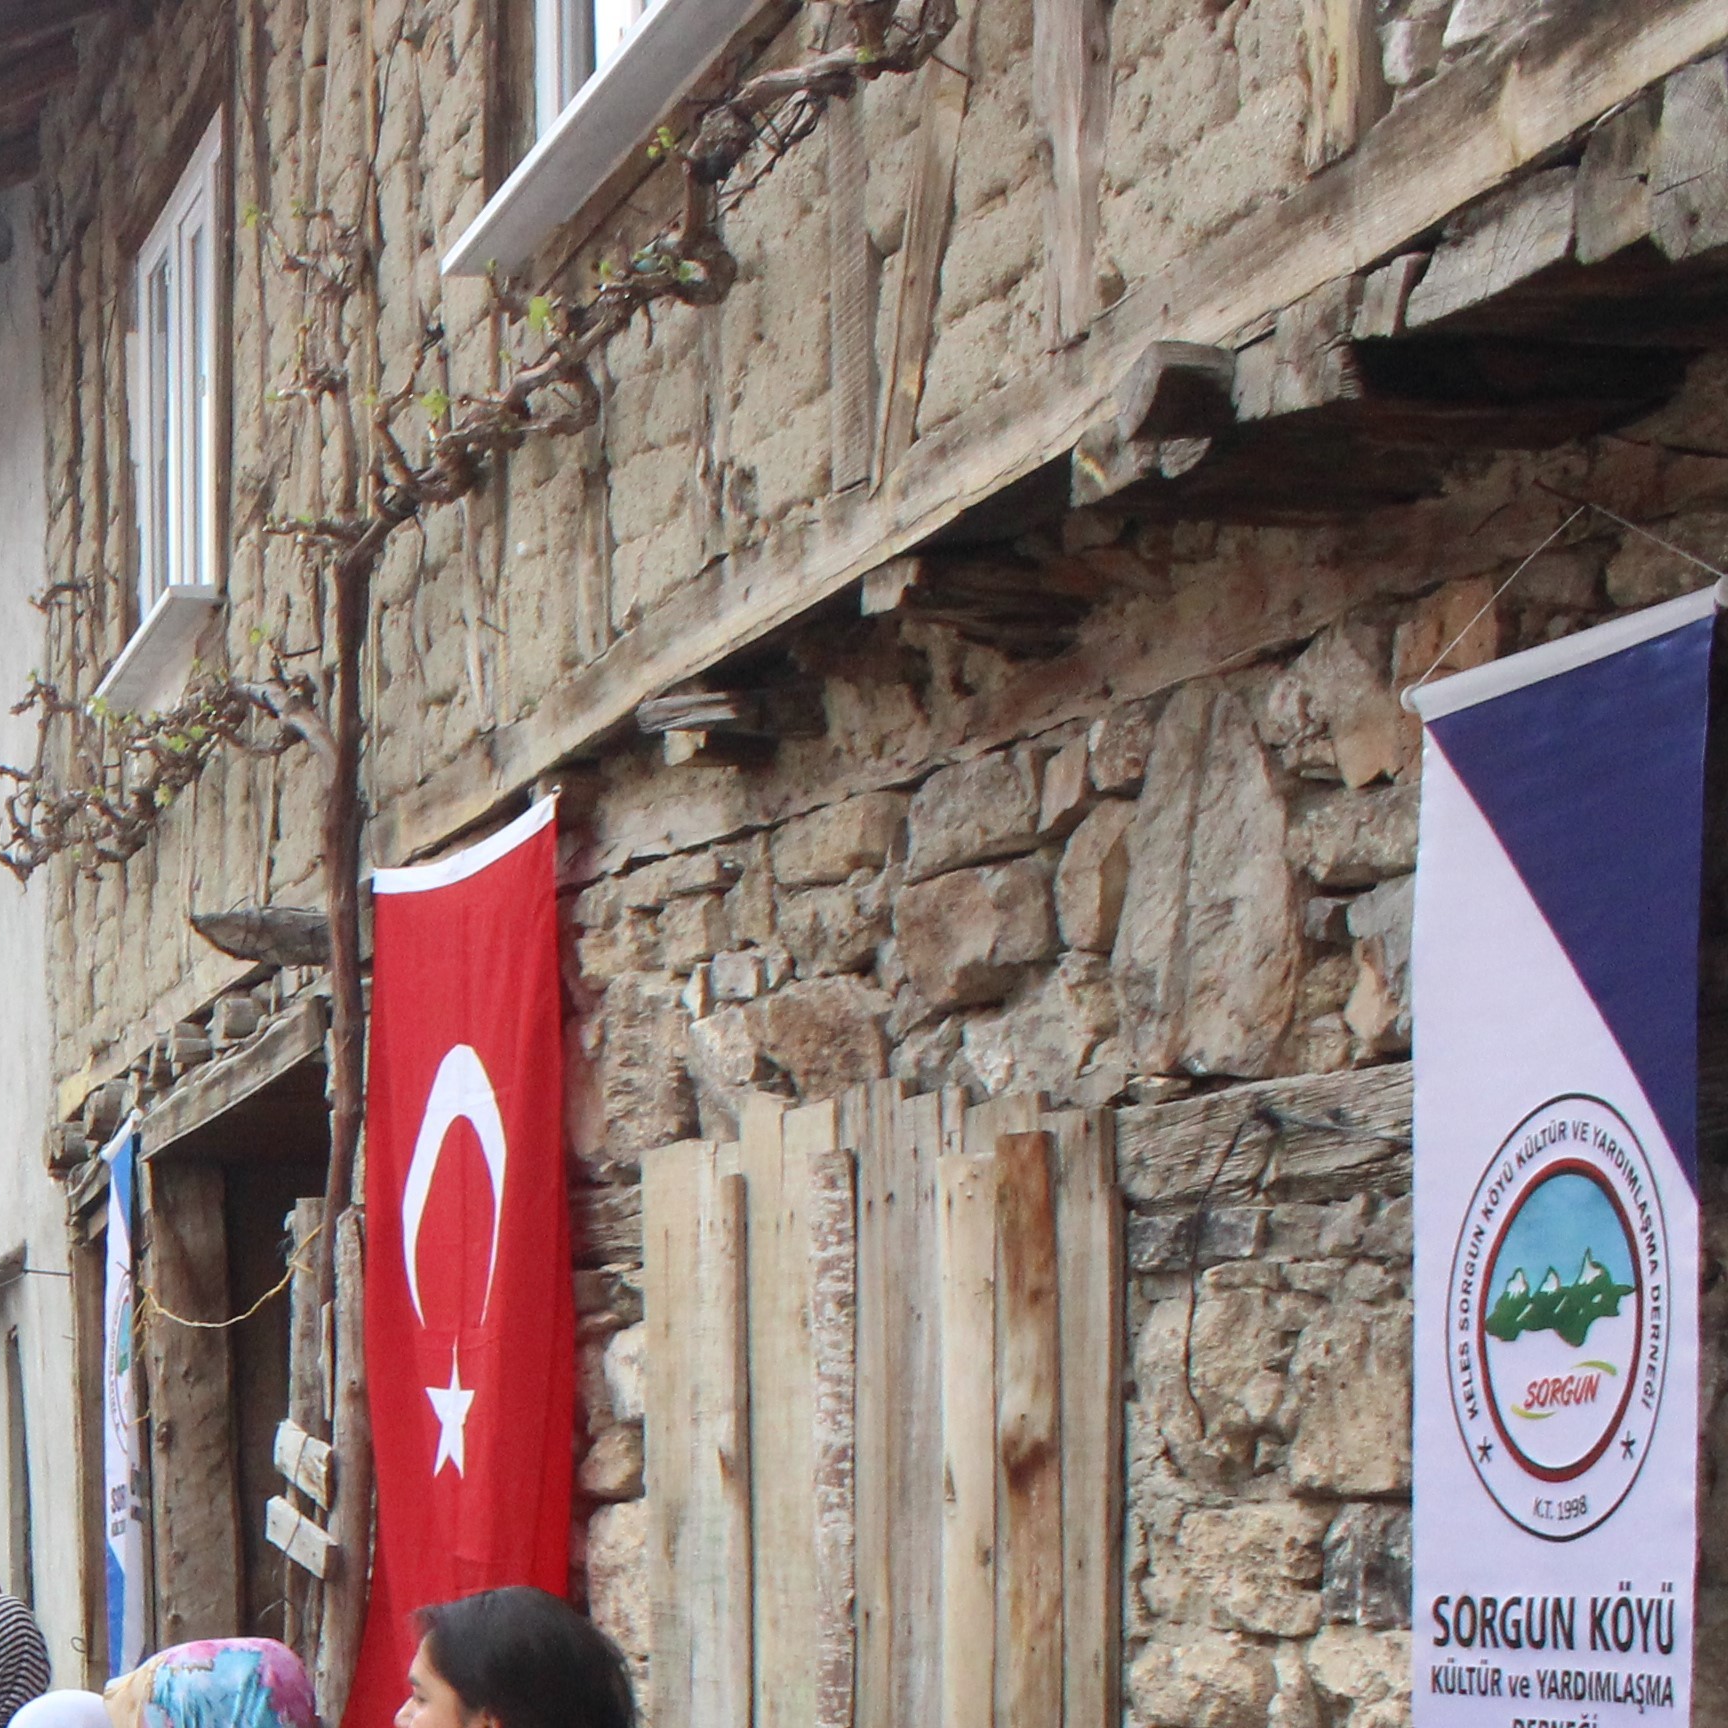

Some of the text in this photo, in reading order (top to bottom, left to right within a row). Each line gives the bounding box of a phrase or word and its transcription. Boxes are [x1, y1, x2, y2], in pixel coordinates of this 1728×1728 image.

[1457, 1224, 1486, 1336] SORGUN
[1482, 1162, 1514, 1225] KÖYÜ
[1516, 1119, 1569, 1170] KÜLTÜR
[1571, 1120, 1590, 1142] VE
[1592, 1125, 1660, 1276] YARDIMLAŞMA
[1523, 1373, 1602, 1410] SORGUN
[1532, 1495, 1588, 1520] K.T. 1998
[1431, 1581, 1674, 1655] SORGUN KÖYÜ
[1430, 1657, 1674, 1714] KÜLTÜR ve YARDIMLAŞMA
